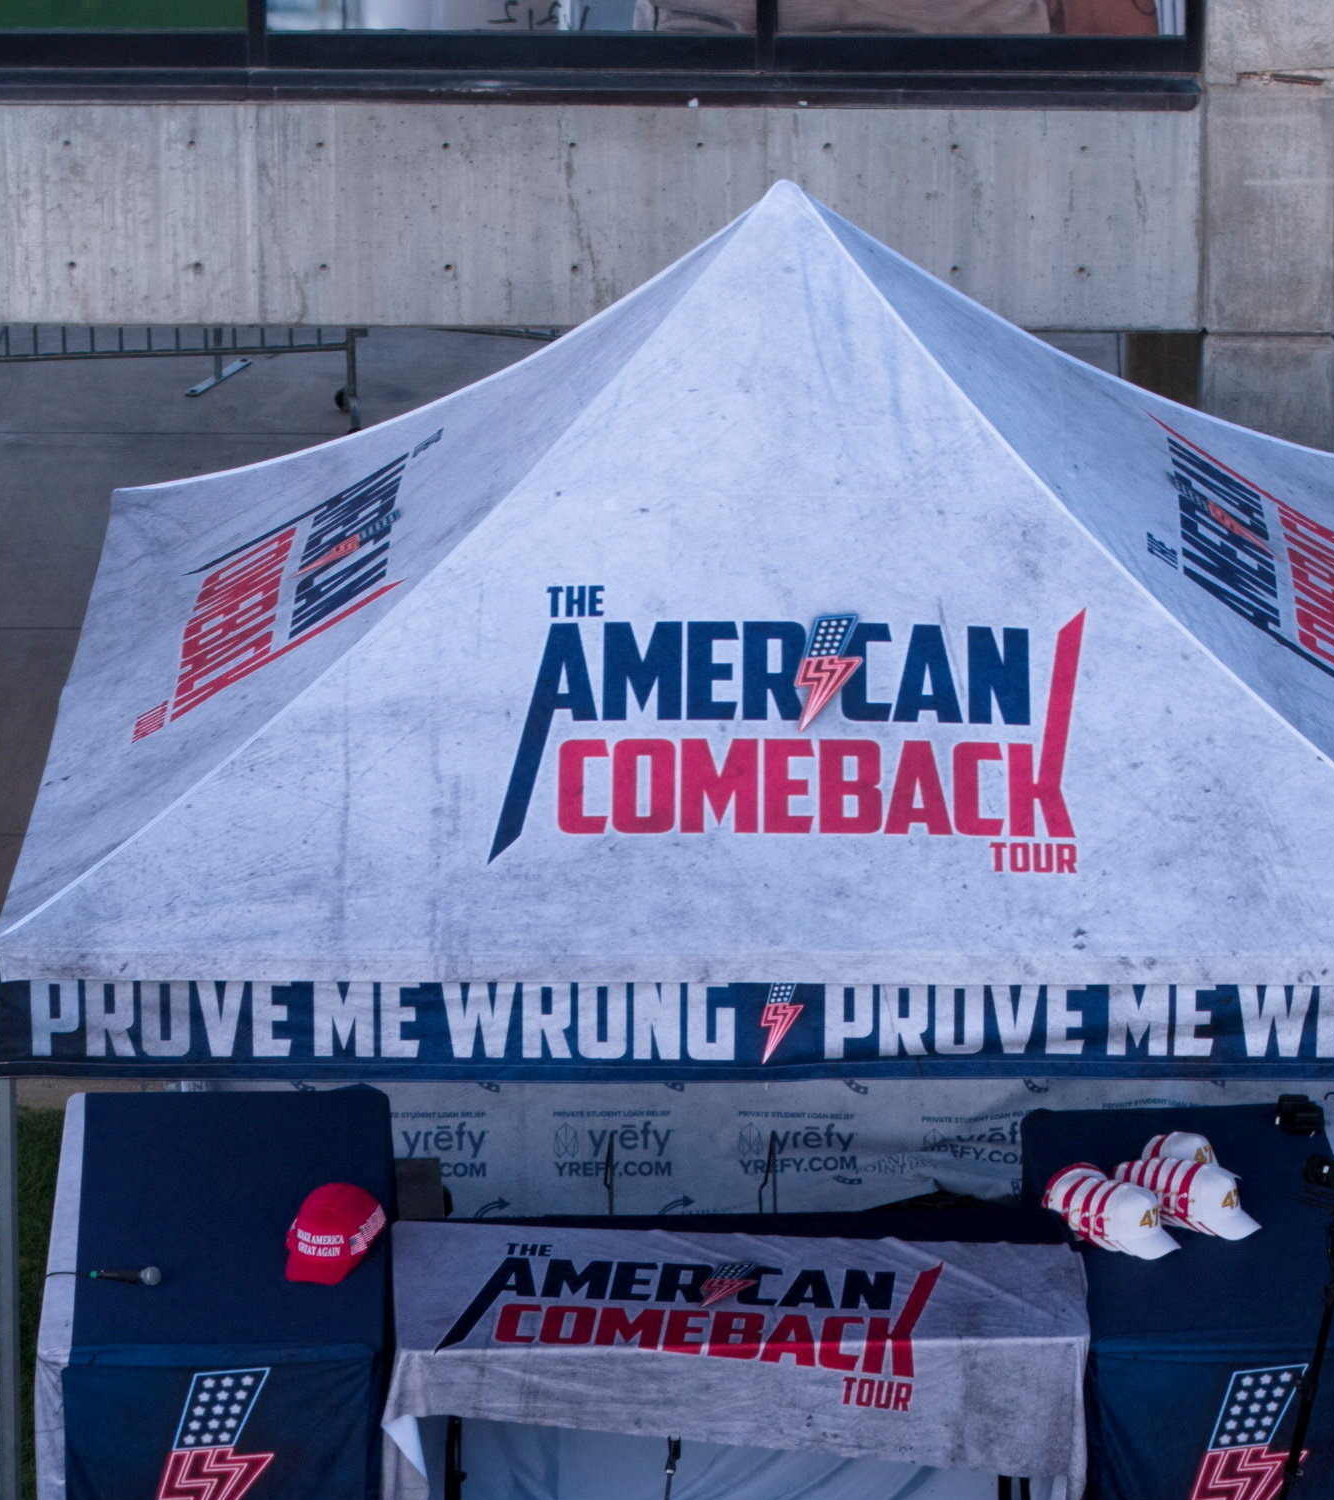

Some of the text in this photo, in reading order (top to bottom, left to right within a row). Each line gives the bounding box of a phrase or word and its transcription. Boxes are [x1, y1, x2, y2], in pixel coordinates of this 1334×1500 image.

[1146, 531, 1178, 568] THE
[547, 585, 605, 617] THE
[169, 527, 407, 723] COMEBACK
[557, 607, 1086, 839] COMEBACK
[989, 841, 1077, 874] TOUR
[29, 980, 293, 1059] PROVE
[313, 980, 419, 1058] ME
[439, 980, 737, 1060] WRONG
[823, 982, 1085, 1060] PROVE
[1107, 983, 1214, 1059] ME
[401, 1111, 435, 1119] STUDENT
[437, 1111, 458, 1119] LOAN
[460, 1110, 486, 1118] RELIEF
[553, 1109, 671, 1118] PRIVATE STUDENT LOAN RELIEF
[738, 1110, 767, 1118] PRIVATE
[771, 1111, 806, 1120] STUDENT
[831, 1112, 855, 1120] RELIEF
[921, 1115, 952, 1124] PRIVATE
[954, 1115, 987, 1124] STUDENT
[990, 1113, 1011, 1122] LOAN
[1193, 1144, 1214, 1163] 47
[555, 1160, 672, 1178] YREFY.COM
[739, 1155, 857, 1175] YREFY.COM
[1221, 1190, 1241, 1209] 47
[1139, 1208, 1161, 1229] 47
[312, 1234, 345, 1245] AMERICA
[316, 1246, 341, 1257] AGAIN
[505, 1242, 553, 1258] THE
[434, 1257, 896, 1355] AMERICAN
[494, 1261, 944, 1377] COMEBACK
[842, 1375, 913, 1412] TOUR
